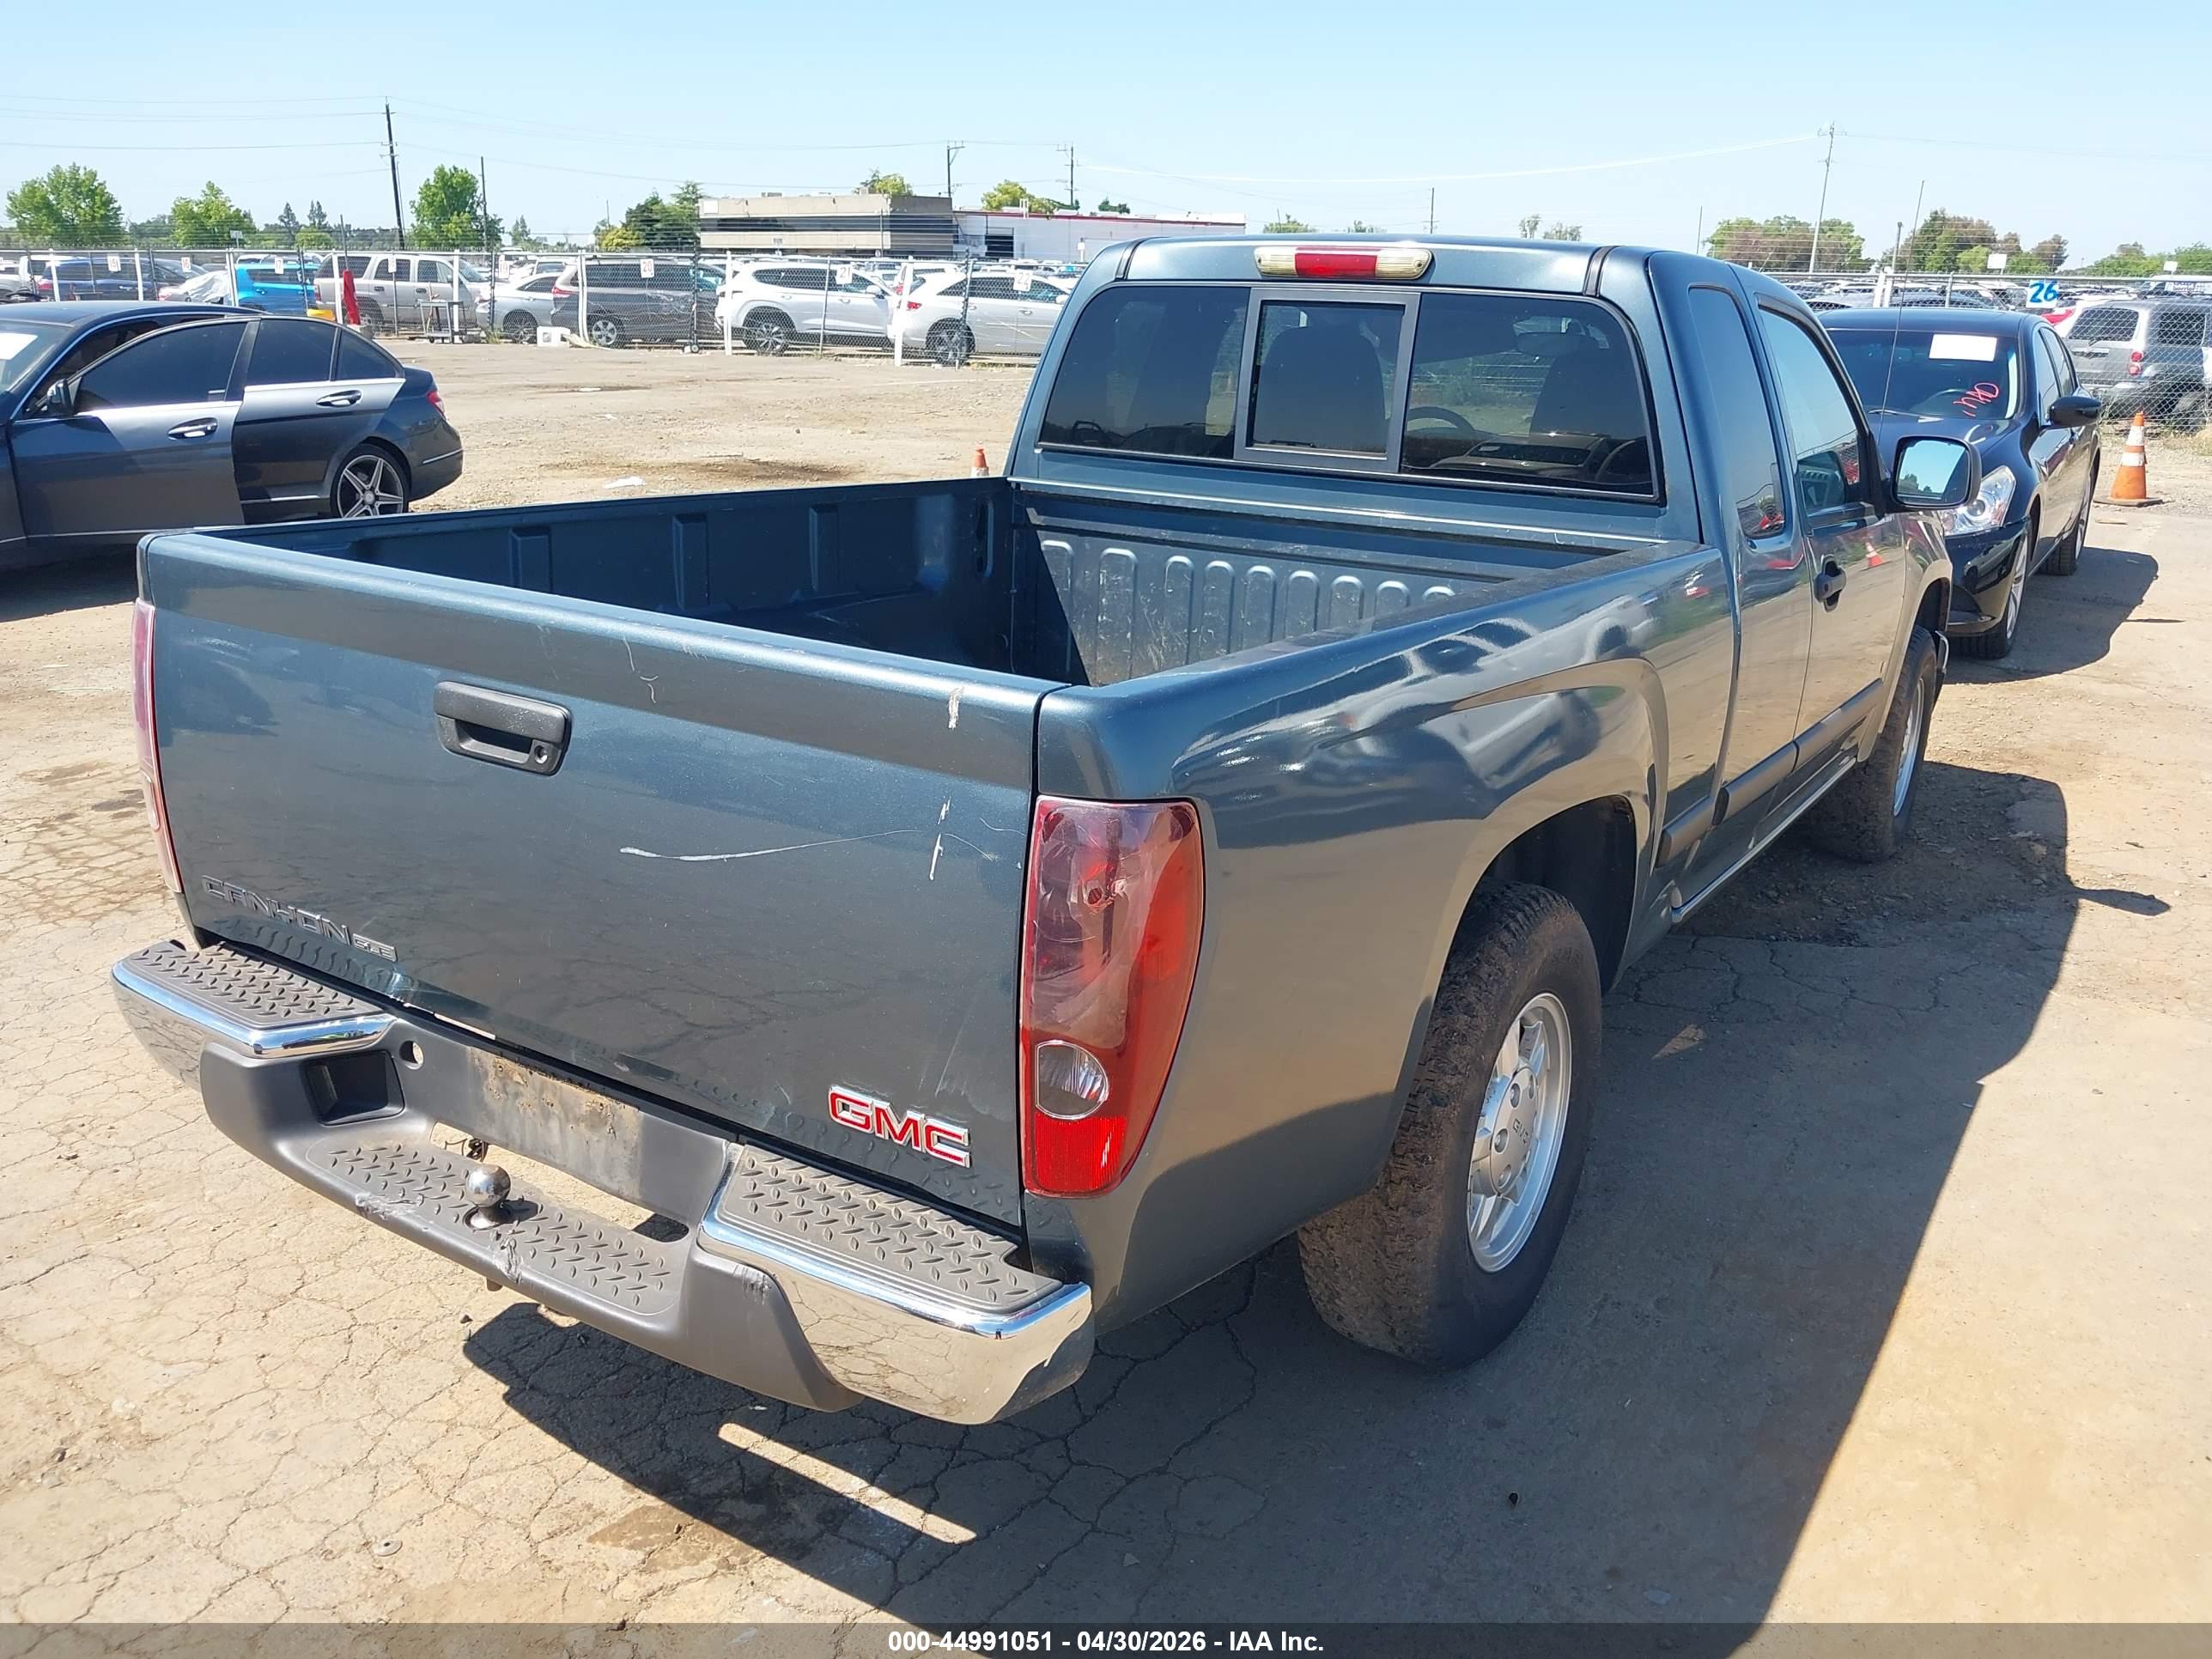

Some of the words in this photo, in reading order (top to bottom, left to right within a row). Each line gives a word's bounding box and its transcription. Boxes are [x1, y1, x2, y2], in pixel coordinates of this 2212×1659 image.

[643, 260, 653, 272] 20
[839, 266, 851, 278] 21
[2029, 280, 2058, 303] 26
[200, 874, 353, 946] CANYON
[828, 1085, 971, 1169] GMC
